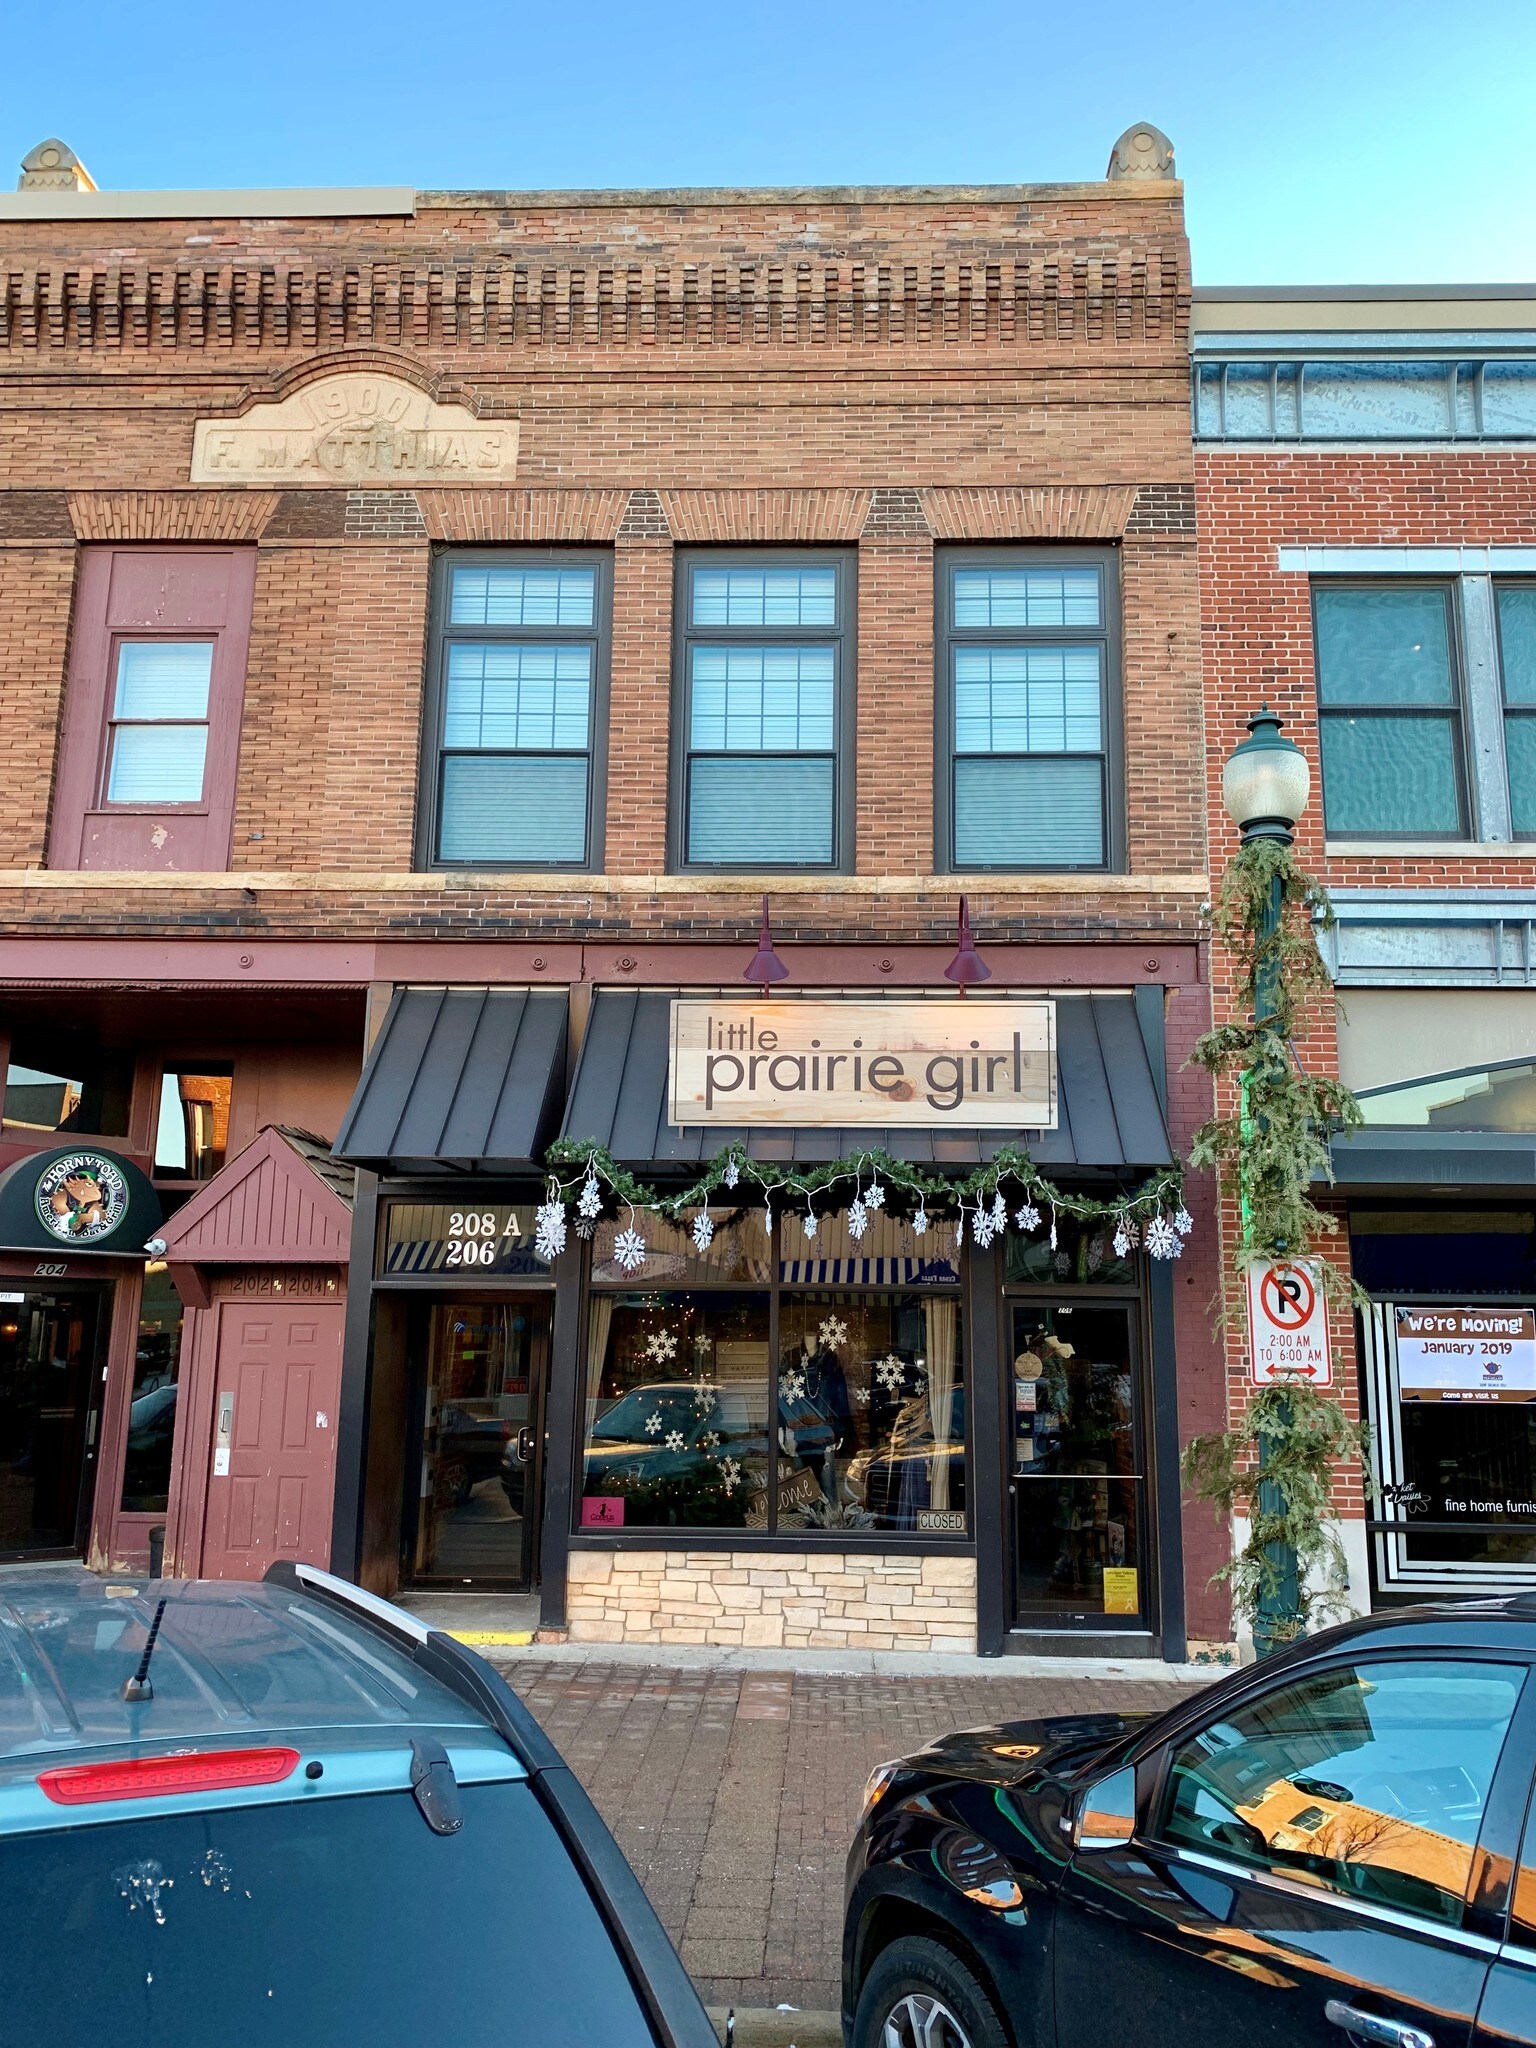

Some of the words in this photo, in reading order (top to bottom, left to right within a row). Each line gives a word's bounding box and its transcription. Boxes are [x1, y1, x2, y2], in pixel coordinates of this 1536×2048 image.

[299, 384, 412, 426] 1900
[257, 435, 501, 468] MATTHIAS
[707, 1016, 779, 1051] little
[706, 1039, 905, 1111] prairie
[926, 1031, 1022, 1111] girl
[448, 1212, 496, 1237] 208
[502, 1212, 522, 1237] A
[446, 1240, 496, 1265] 206
[36, 1264, 66, 1276] 204
[1408, 1315, 1457, 1332] We're
[1270, 1334, 1293, 1347] 2:00
[1296, 1334, 1311, 1347] AM
[1421, 1342, 1475, 1356] January
[1481, 1342, 1513, 1355] 2019
[1260, 1348, 1273, 1361] TO
[1280, 1349, 1302, 1362] 6:00
[1307, 1349, 1322, 1362] AM
[1445, 1498, 1467, 1512] fine
[1470, 1499, 1504, 1513] home
[920, 1513, 963, 1529] CLOSED
